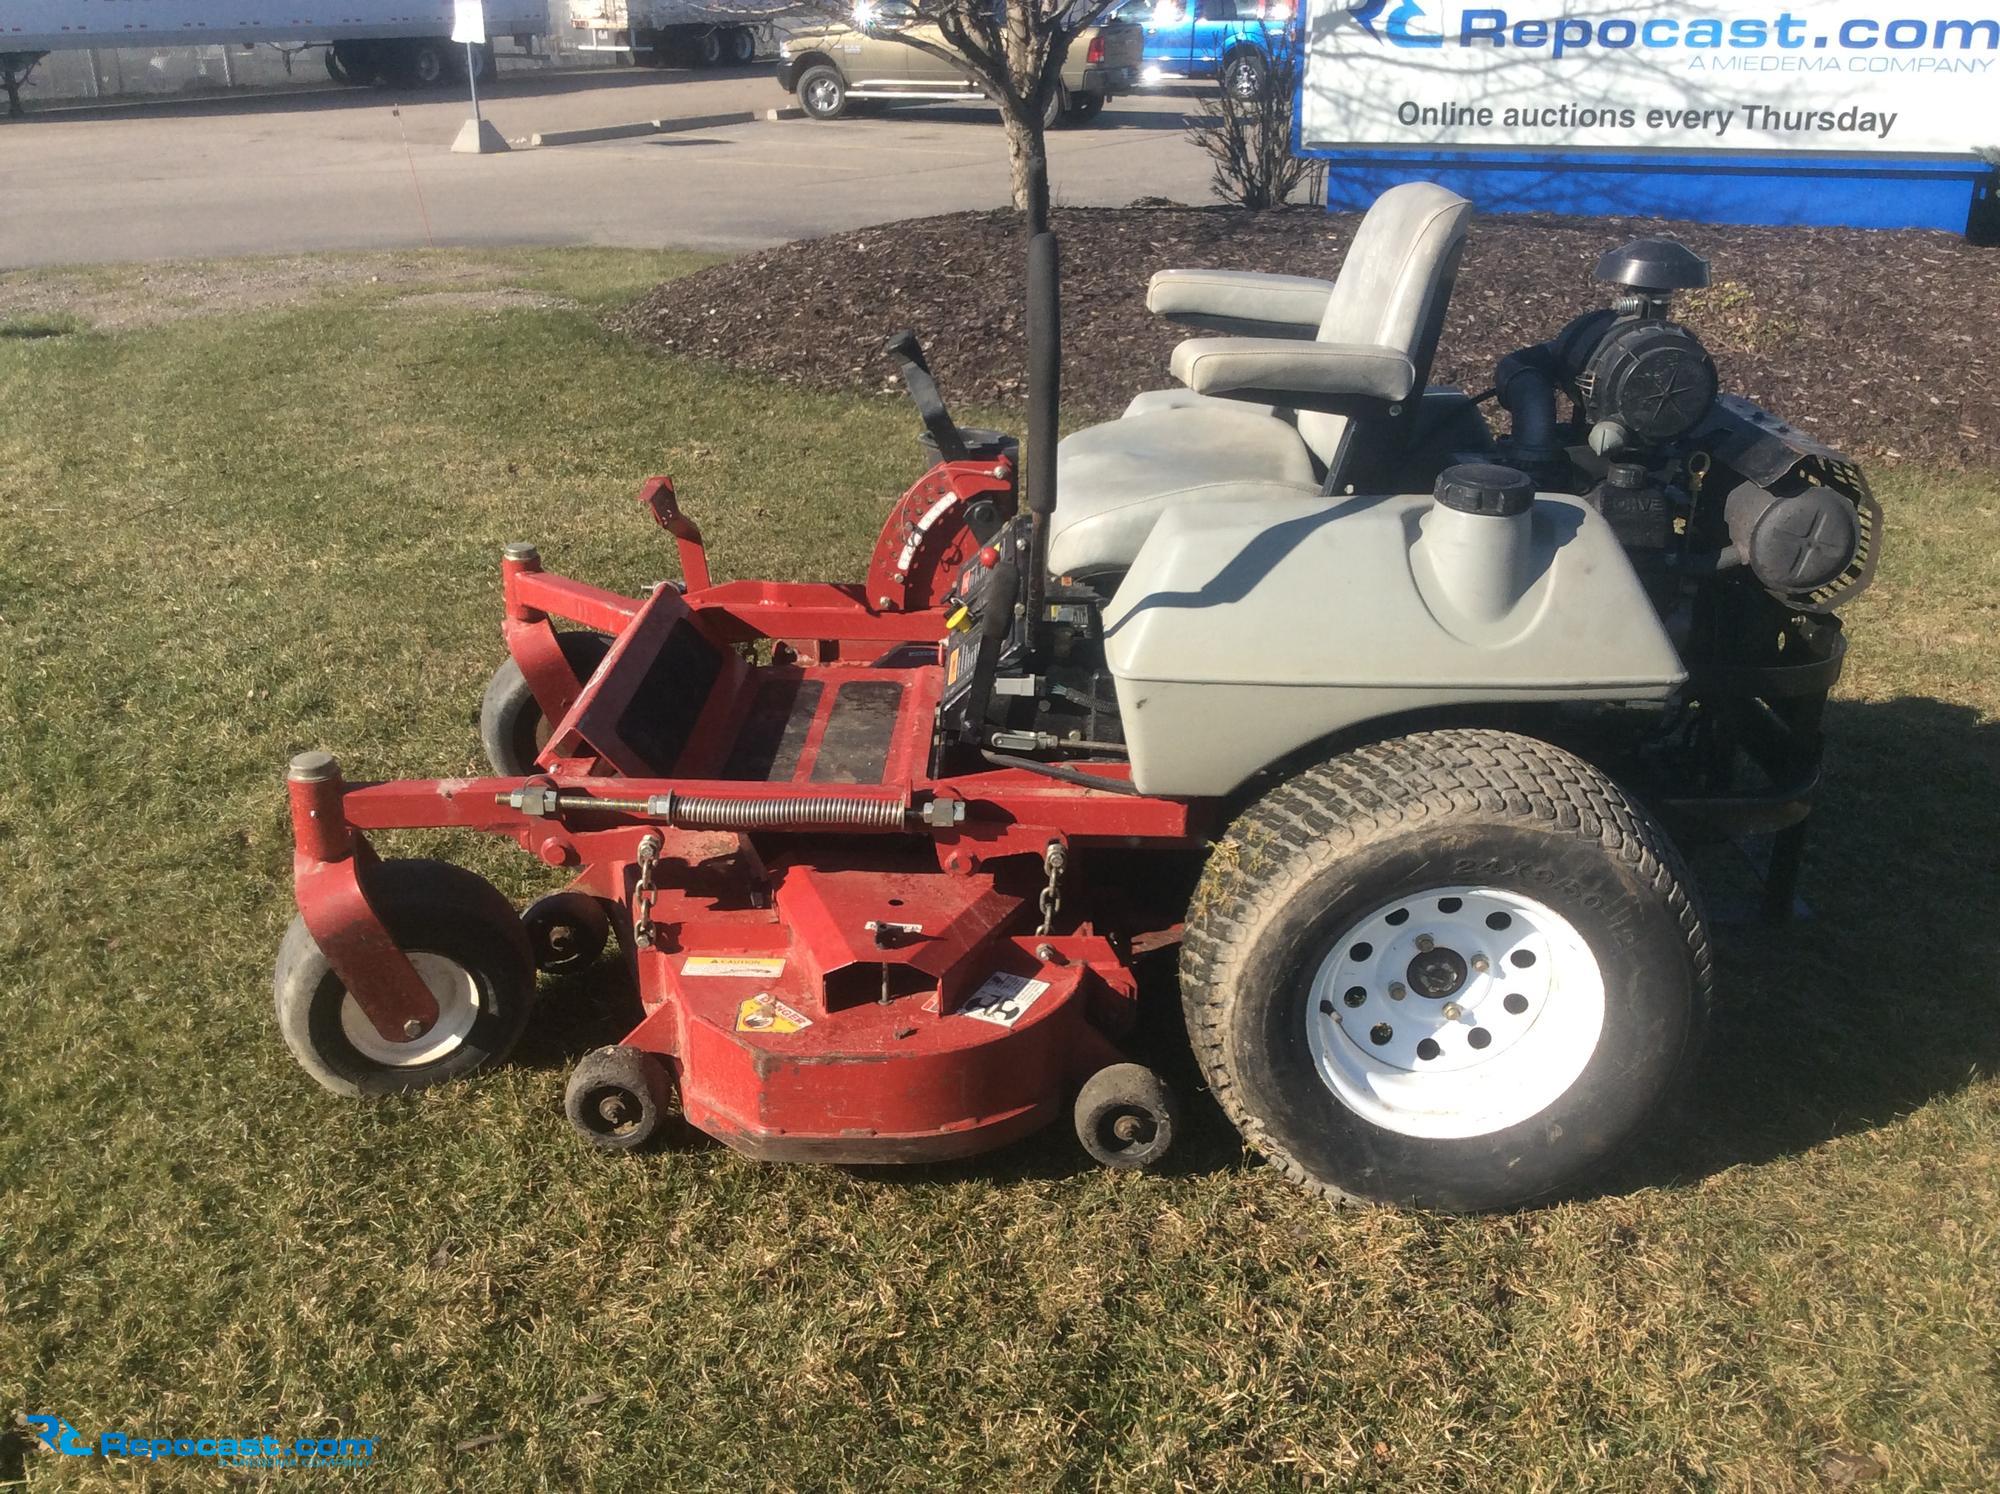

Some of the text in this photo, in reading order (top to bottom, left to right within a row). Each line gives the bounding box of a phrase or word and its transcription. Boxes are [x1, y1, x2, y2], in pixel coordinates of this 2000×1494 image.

[1459, 9, 2000, 59] Repocast.com
[1688, 56, 1995, 73] A MIEDEMA COMPANY
[1397, 101, 1898, 139] Online auctions every Thursday
